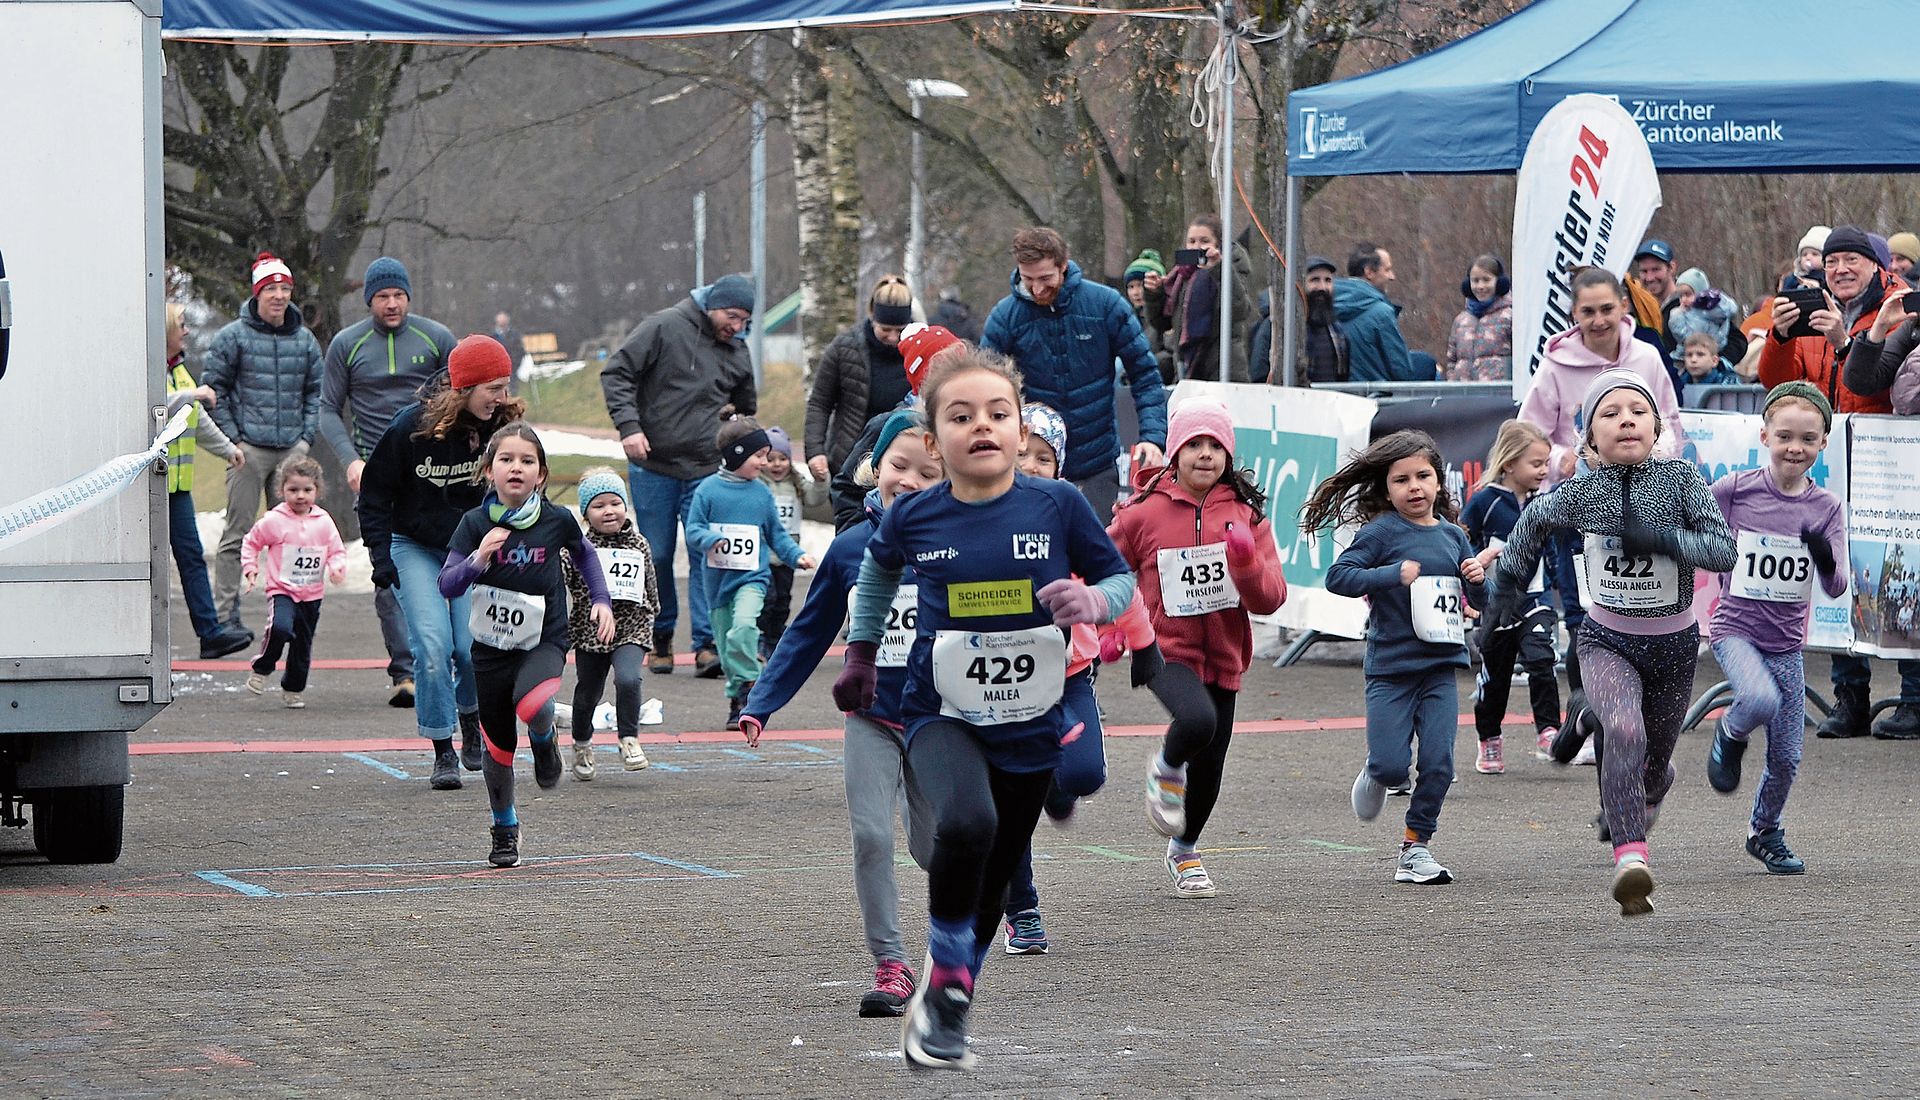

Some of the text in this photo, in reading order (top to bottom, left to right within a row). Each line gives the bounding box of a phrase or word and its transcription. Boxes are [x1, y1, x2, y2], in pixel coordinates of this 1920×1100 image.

[1632, 99, 1715, 122] Zürcher
[777, 506, 795, 518] 32
[1018, 534, 1050, 542] MEILEN
[1013, 534, 1049, 559] LCM
[294, 556, 321, 569] 428
[497, 547, 546, 565] LOVE
[916, 549, 947, 562] CRAFT
[609, 562, 640, 579] 427
[1180, 561, 1225, 586] 433
[1603, 555, 1655, 578] 422
[1745, 552, 1810, 583] 1003
[1185, 584, 1224, 599] PERSEFONI
[1599, 579, 1662, 591] ALESSIA ANGELA
[958, 589, 1022, 600] SCHNEIDER
[958, 599, 1022, 609] UMWELTSERVICE
[485, 604, 525, 627] 430
[884, 606, 918, 631] 26
[880, 635, 906, 646] AMIE
[985, 634, 1013, 642] Zürcher
[985, 639, 1036, 649] Kantonalbank
[965, 653, 1036, 685] 429
[983, 688, 1021, 702] MALEA
